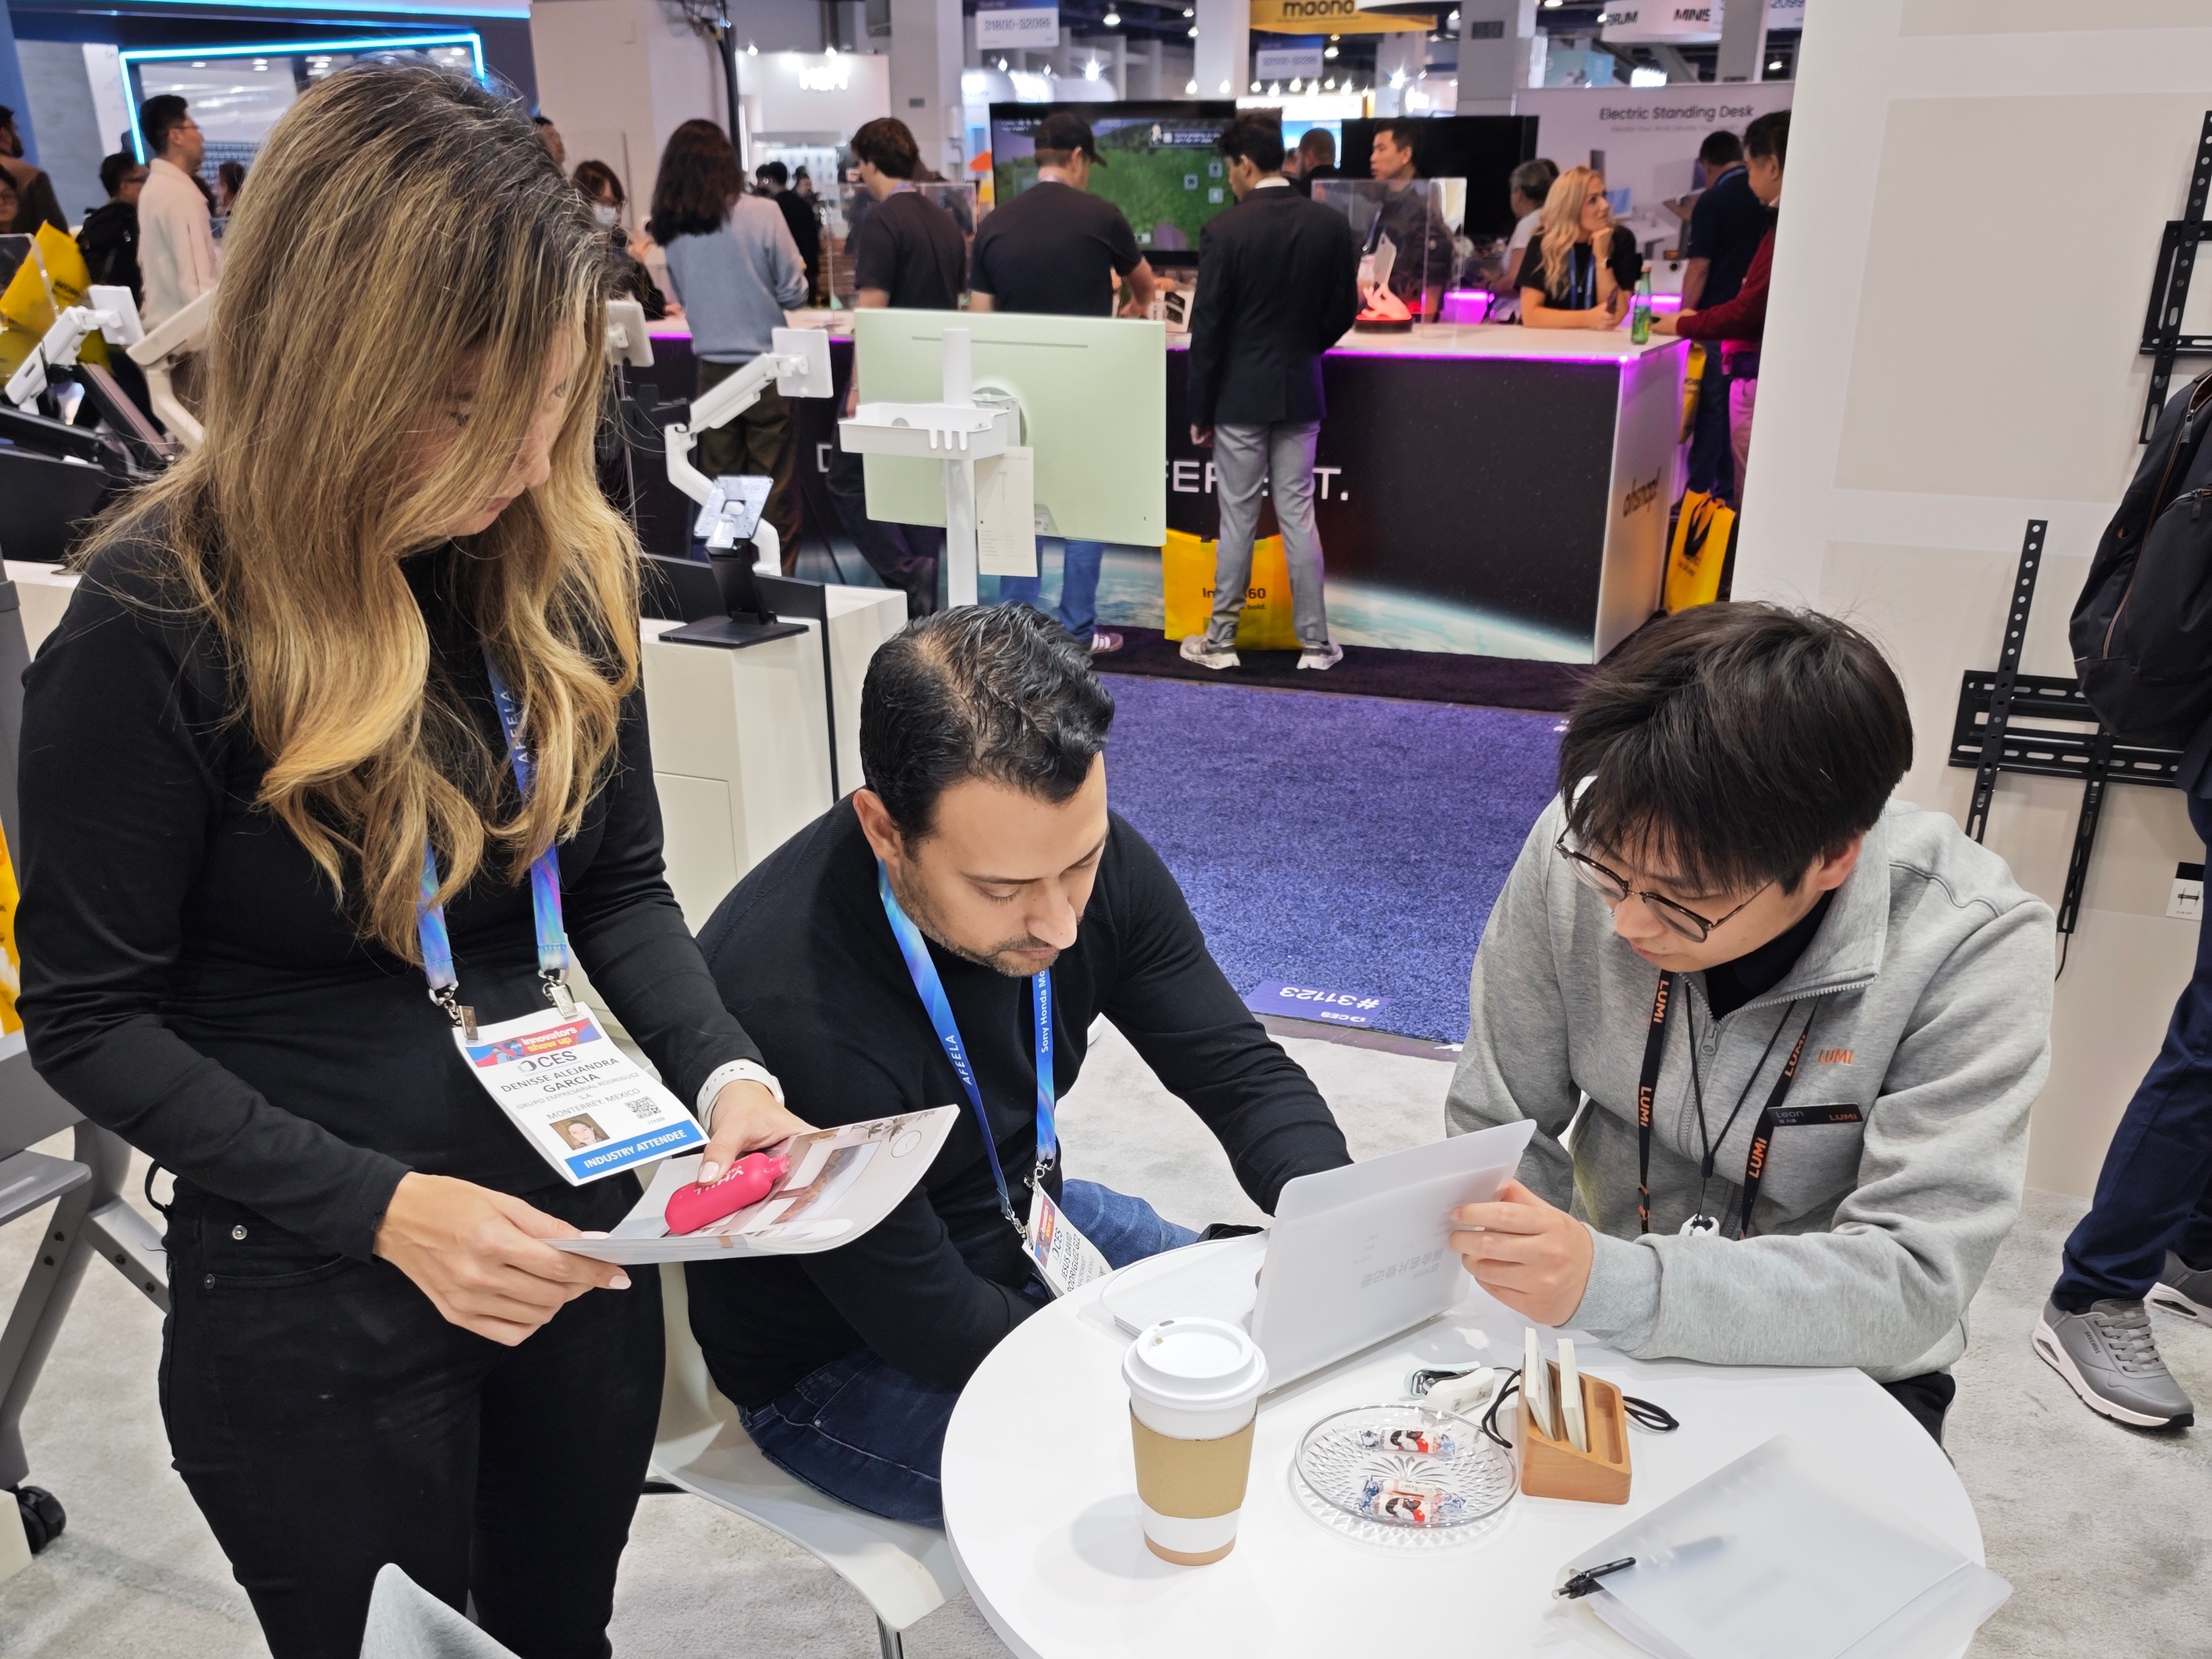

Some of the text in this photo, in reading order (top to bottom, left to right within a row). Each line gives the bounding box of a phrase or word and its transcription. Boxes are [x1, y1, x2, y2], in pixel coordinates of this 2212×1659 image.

[1283, 0, 1354, 17] maono
[1599, 104, 1755, 122] Electric Standing Desk
[1280, 986, 1380, 1010] #31123
[1653, 980, 1669, 1023] LUMI
[521, 1027, 577, 1046] innovators
[527, 1036, 572, 1052] show up
[538, 1051, 577, 1067] CES
[945, 1035, 972, 1086] AFEELA
[1817, 1048, 1854, 1065] LUMI
[500, 1058, 619, 1092] DENISSE ALEJANDRA
[543, 1074, 601, 1092] GARCIA
[516, 1098, 545, 1110] GRUPO
[547, 1084, 598, 1101] EMPRESARIAL
[605, 1088, 640, 1102] MEXICO
[1640, 1086, 1652, 1128] LUMI
[583, 1129, 687, 1169] INDUSTRY ATTENDEE
[1748, 1137, 1767, 1178] LUMI
[1053, 1227, 1063, 1251] CES
[1061, 1254, 1071, 1281] JESUS
